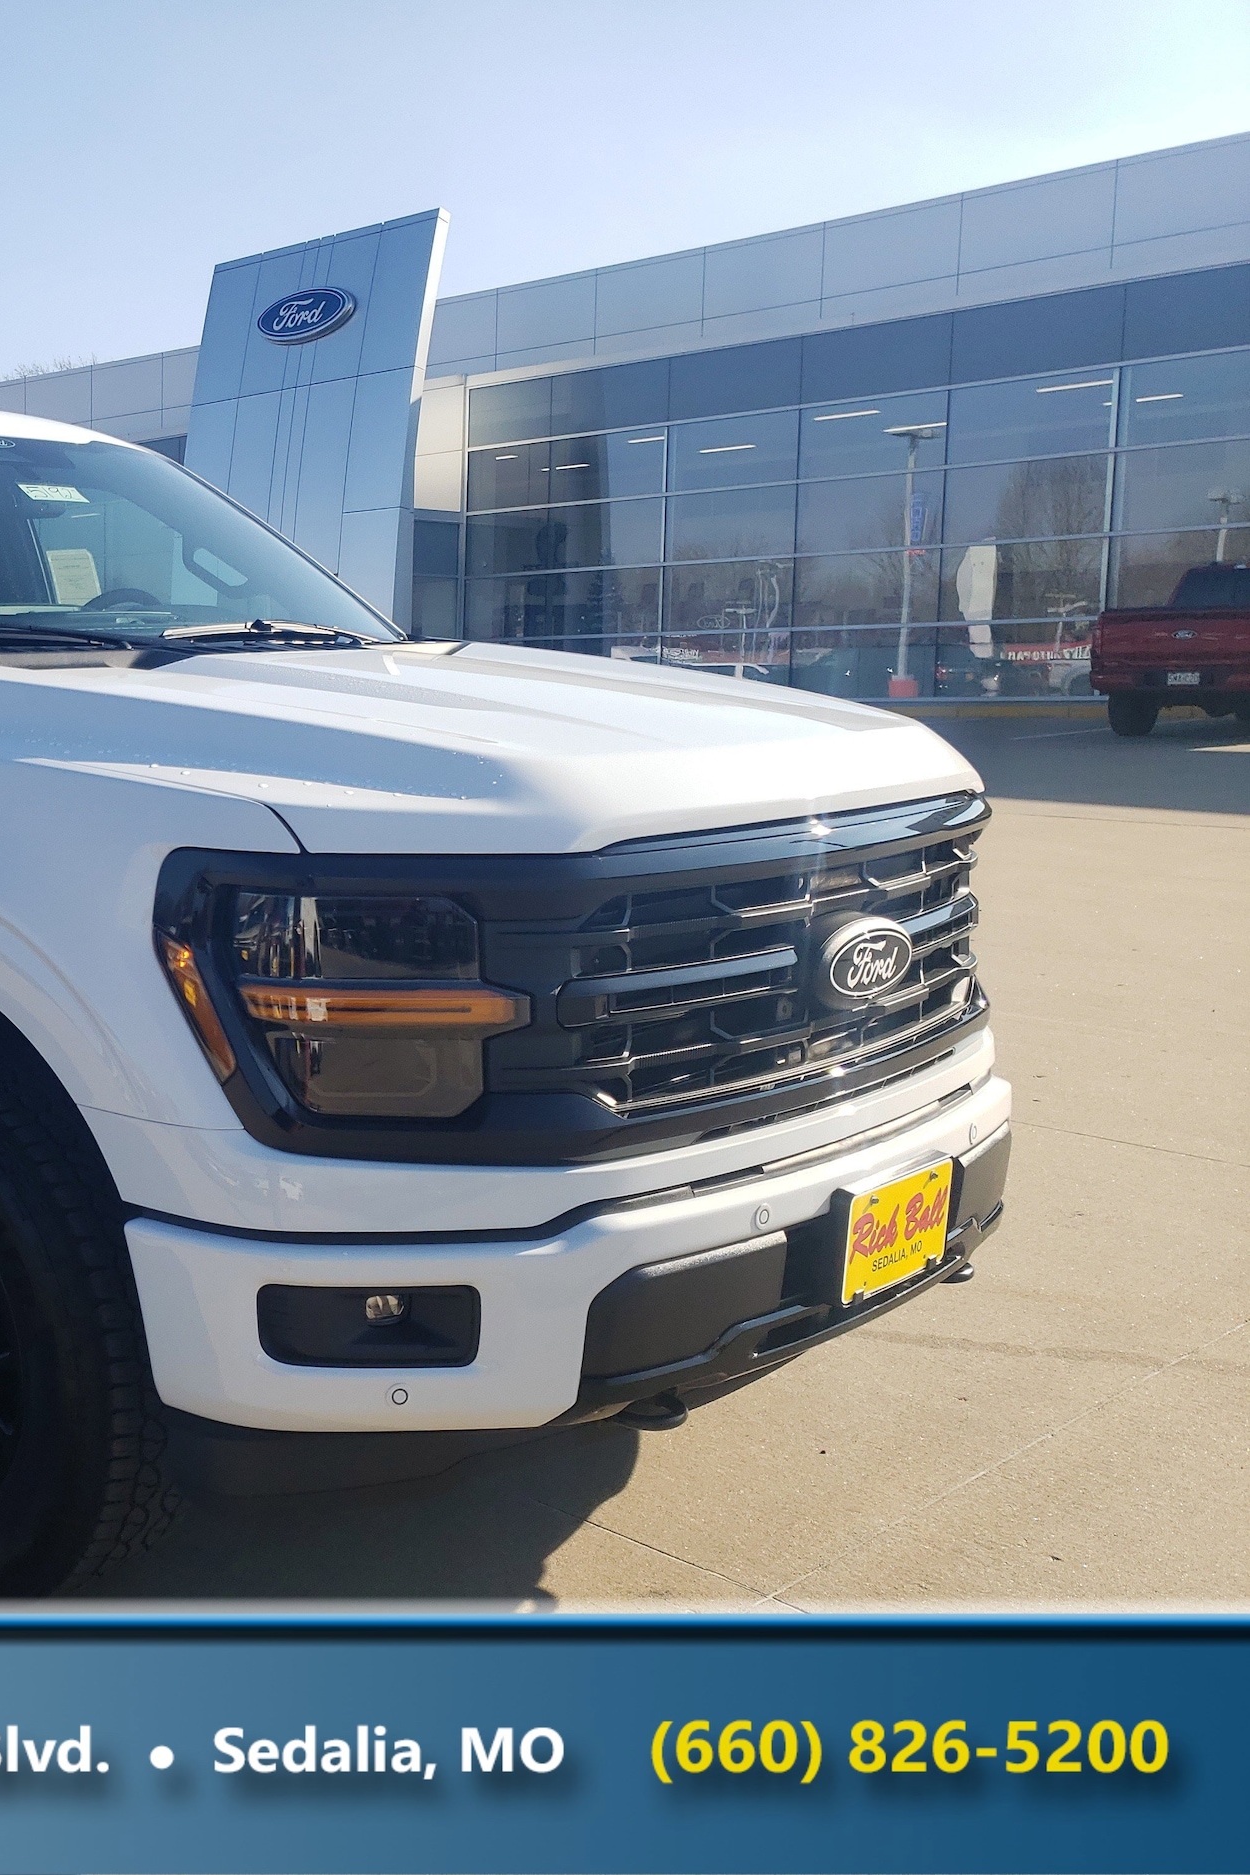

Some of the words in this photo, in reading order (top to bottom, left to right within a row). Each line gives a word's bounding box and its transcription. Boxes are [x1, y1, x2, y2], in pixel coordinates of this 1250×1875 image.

[273, 298, 326, 331] Ford
[847, 939, 899, 989] Ford
[849, 1203, 899, 1266] Rick
[903, 1184, 948, 1240] Ball
[871, 1247, 908, 1272] SEDALIA,
[910, 1240, 923, 1255] MO
